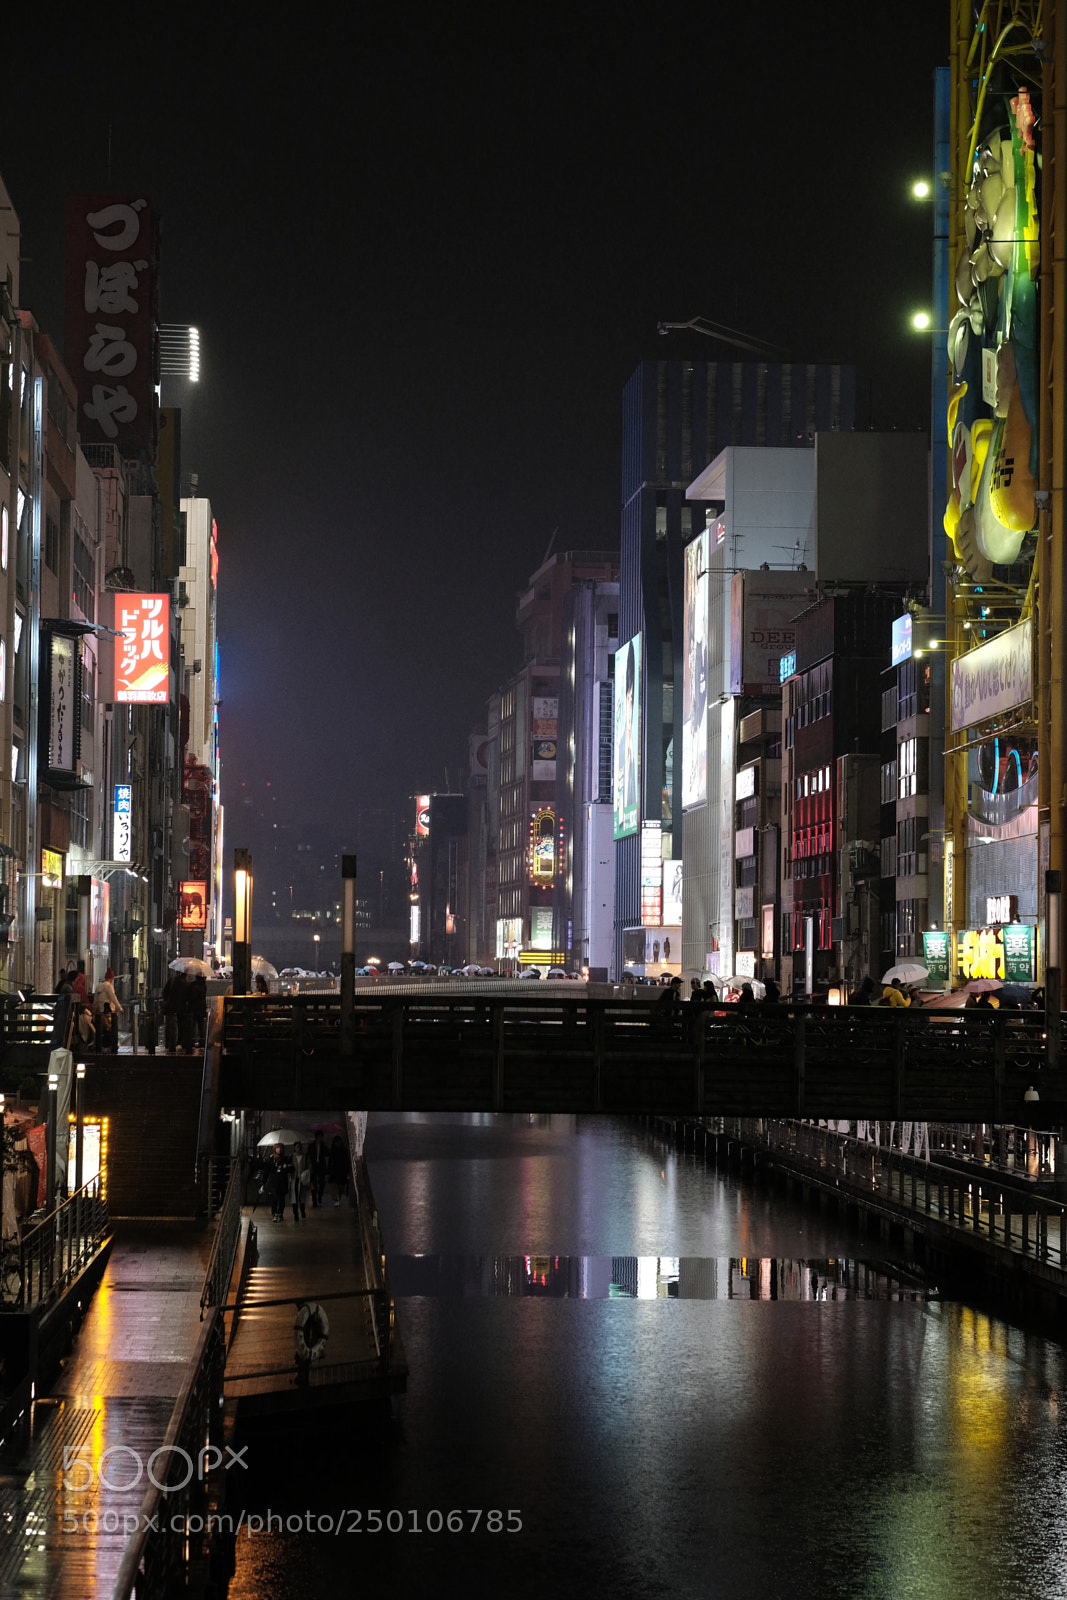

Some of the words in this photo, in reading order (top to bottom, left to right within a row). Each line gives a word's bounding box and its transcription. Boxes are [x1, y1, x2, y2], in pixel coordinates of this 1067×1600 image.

[83, 198, 148, 438] づぼらや
[120, 609, 140, 676] ドラッグ
[140, 599, 164, 660] ツルハ
[118, 787, 130, 812] 焼肉
[118, 814, 129, 860] いろりや
[926, 939, 947, 959] 薬
[1006, 934, 1029, 956] 薬
